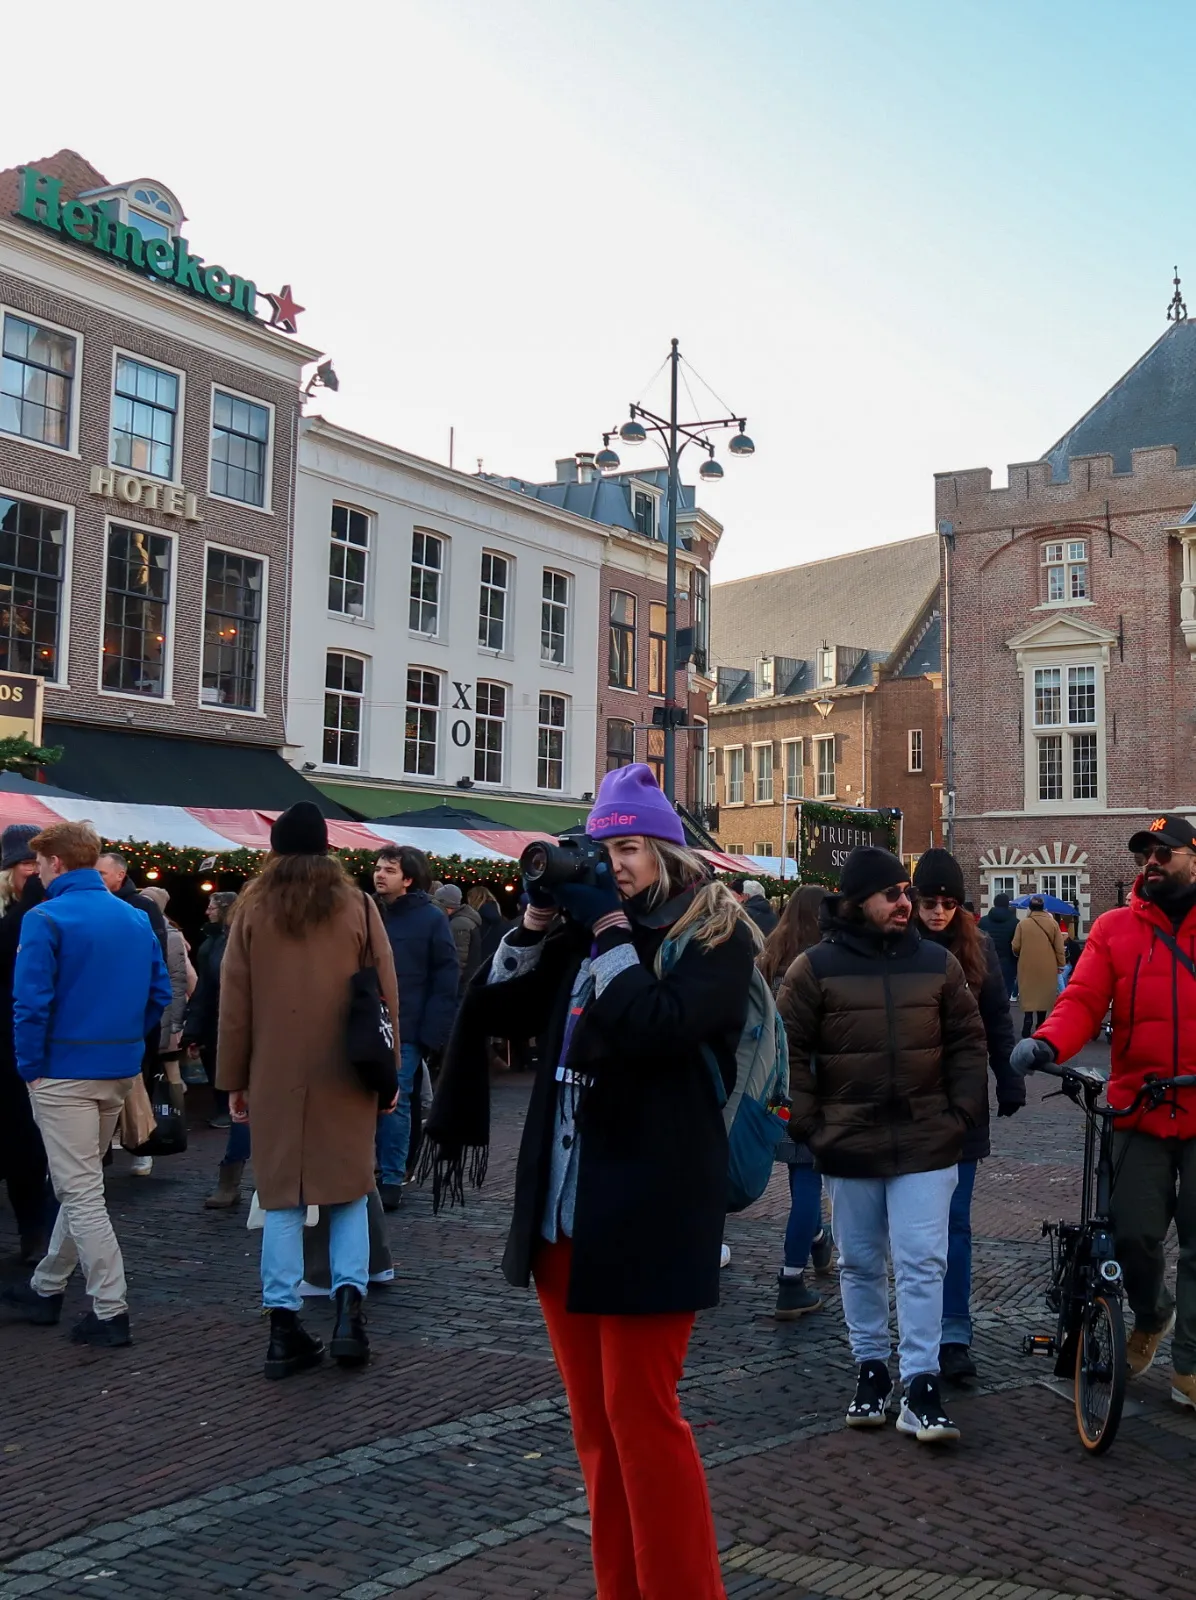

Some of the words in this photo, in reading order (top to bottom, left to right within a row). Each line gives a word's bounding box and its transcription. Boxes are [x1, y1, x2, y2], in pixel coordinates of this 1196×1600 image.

[14, 165, 258, 316] Heineken
[90, 465, 204, 521] HOTEL
[821, 825, 875, 848] TRUFFEL
[1150, 818, 1167, 831] NY
